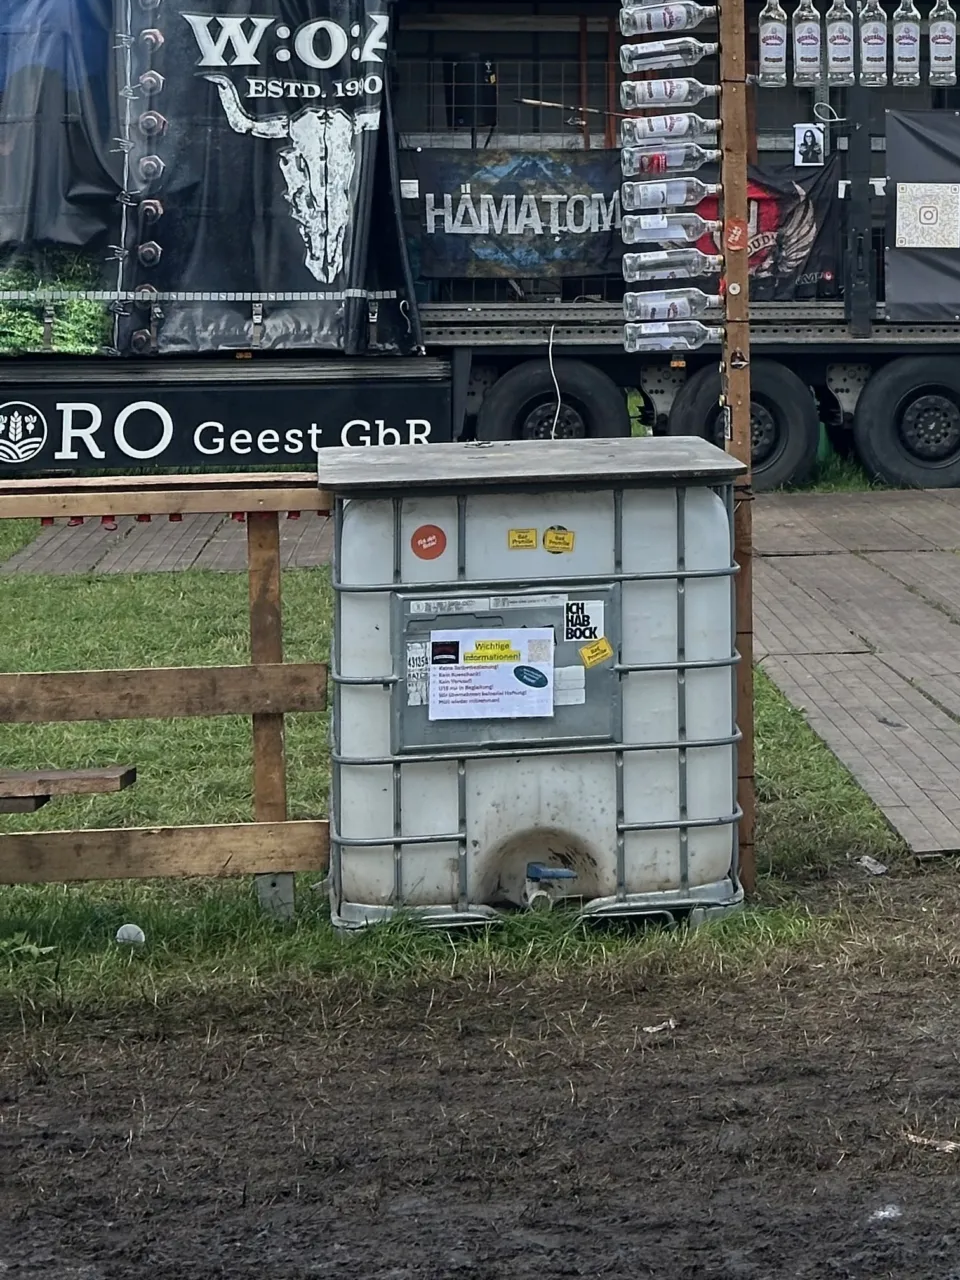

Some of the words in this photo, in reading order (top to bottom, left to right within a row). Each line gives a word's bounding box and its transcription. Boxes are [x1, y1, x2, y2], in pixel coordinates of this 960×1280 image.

[246, 77, 327, 99] ESTD.
[193, 420, 321, 456] Geest
[340, 419, 432, 447] GbR
[565, 602, 585, 615] ICH
[565, 614, 591, 627] HAB
[565, 626, 598, 640] BOCK
[475, 641, 510, 652] Wichtige
[463, 652, 521, 661] Informationen!
